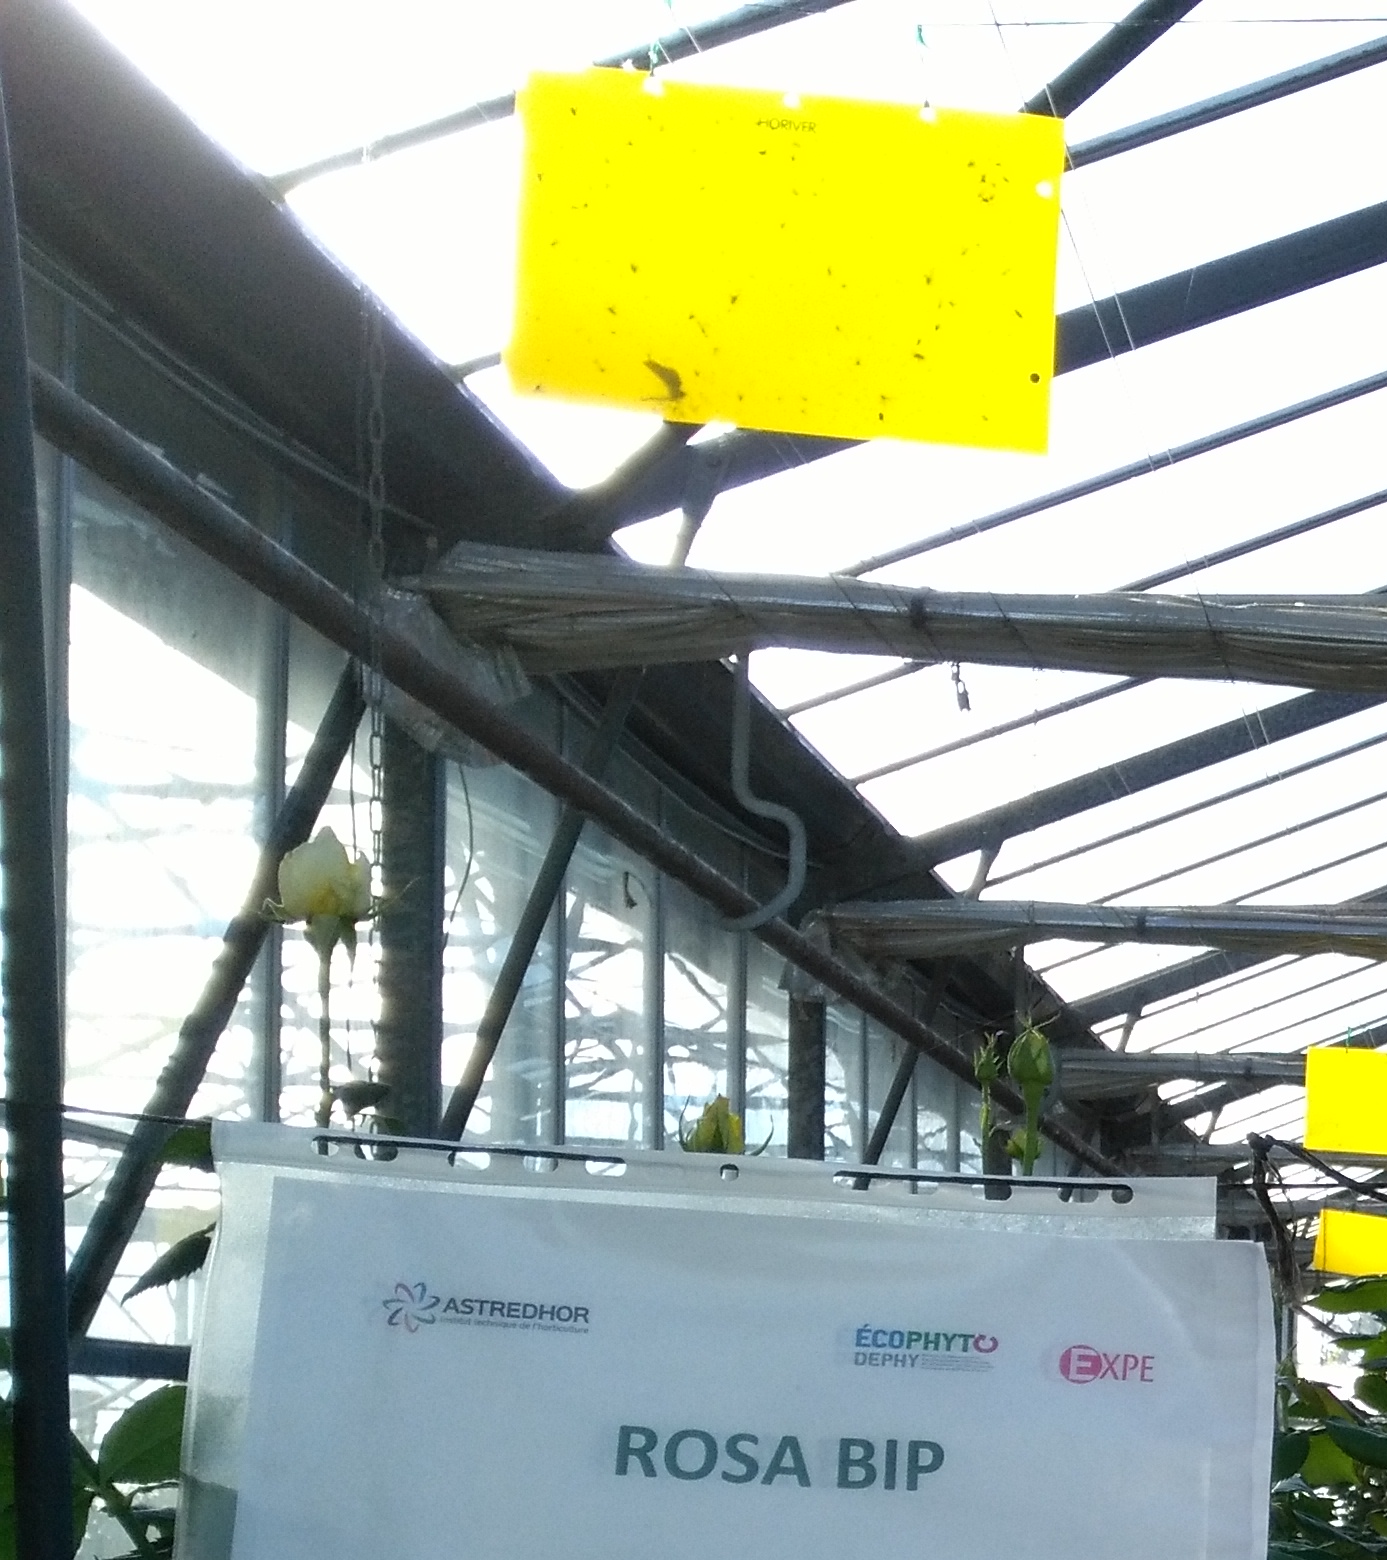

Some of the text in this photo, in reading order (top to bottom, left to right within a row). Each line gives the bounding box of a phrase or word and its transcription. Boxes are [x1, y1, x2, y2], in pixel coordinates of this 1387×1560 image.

[757, 117, 816, 134] HORIVER
[443, 1297, 590, 1323] ASTREDHOR
[855, 1353, 920, 1368] DEPHY
[1059, 1345, 1155, 1383] EXPE
[614, 1423, 945, 1492] ROSA BIP
